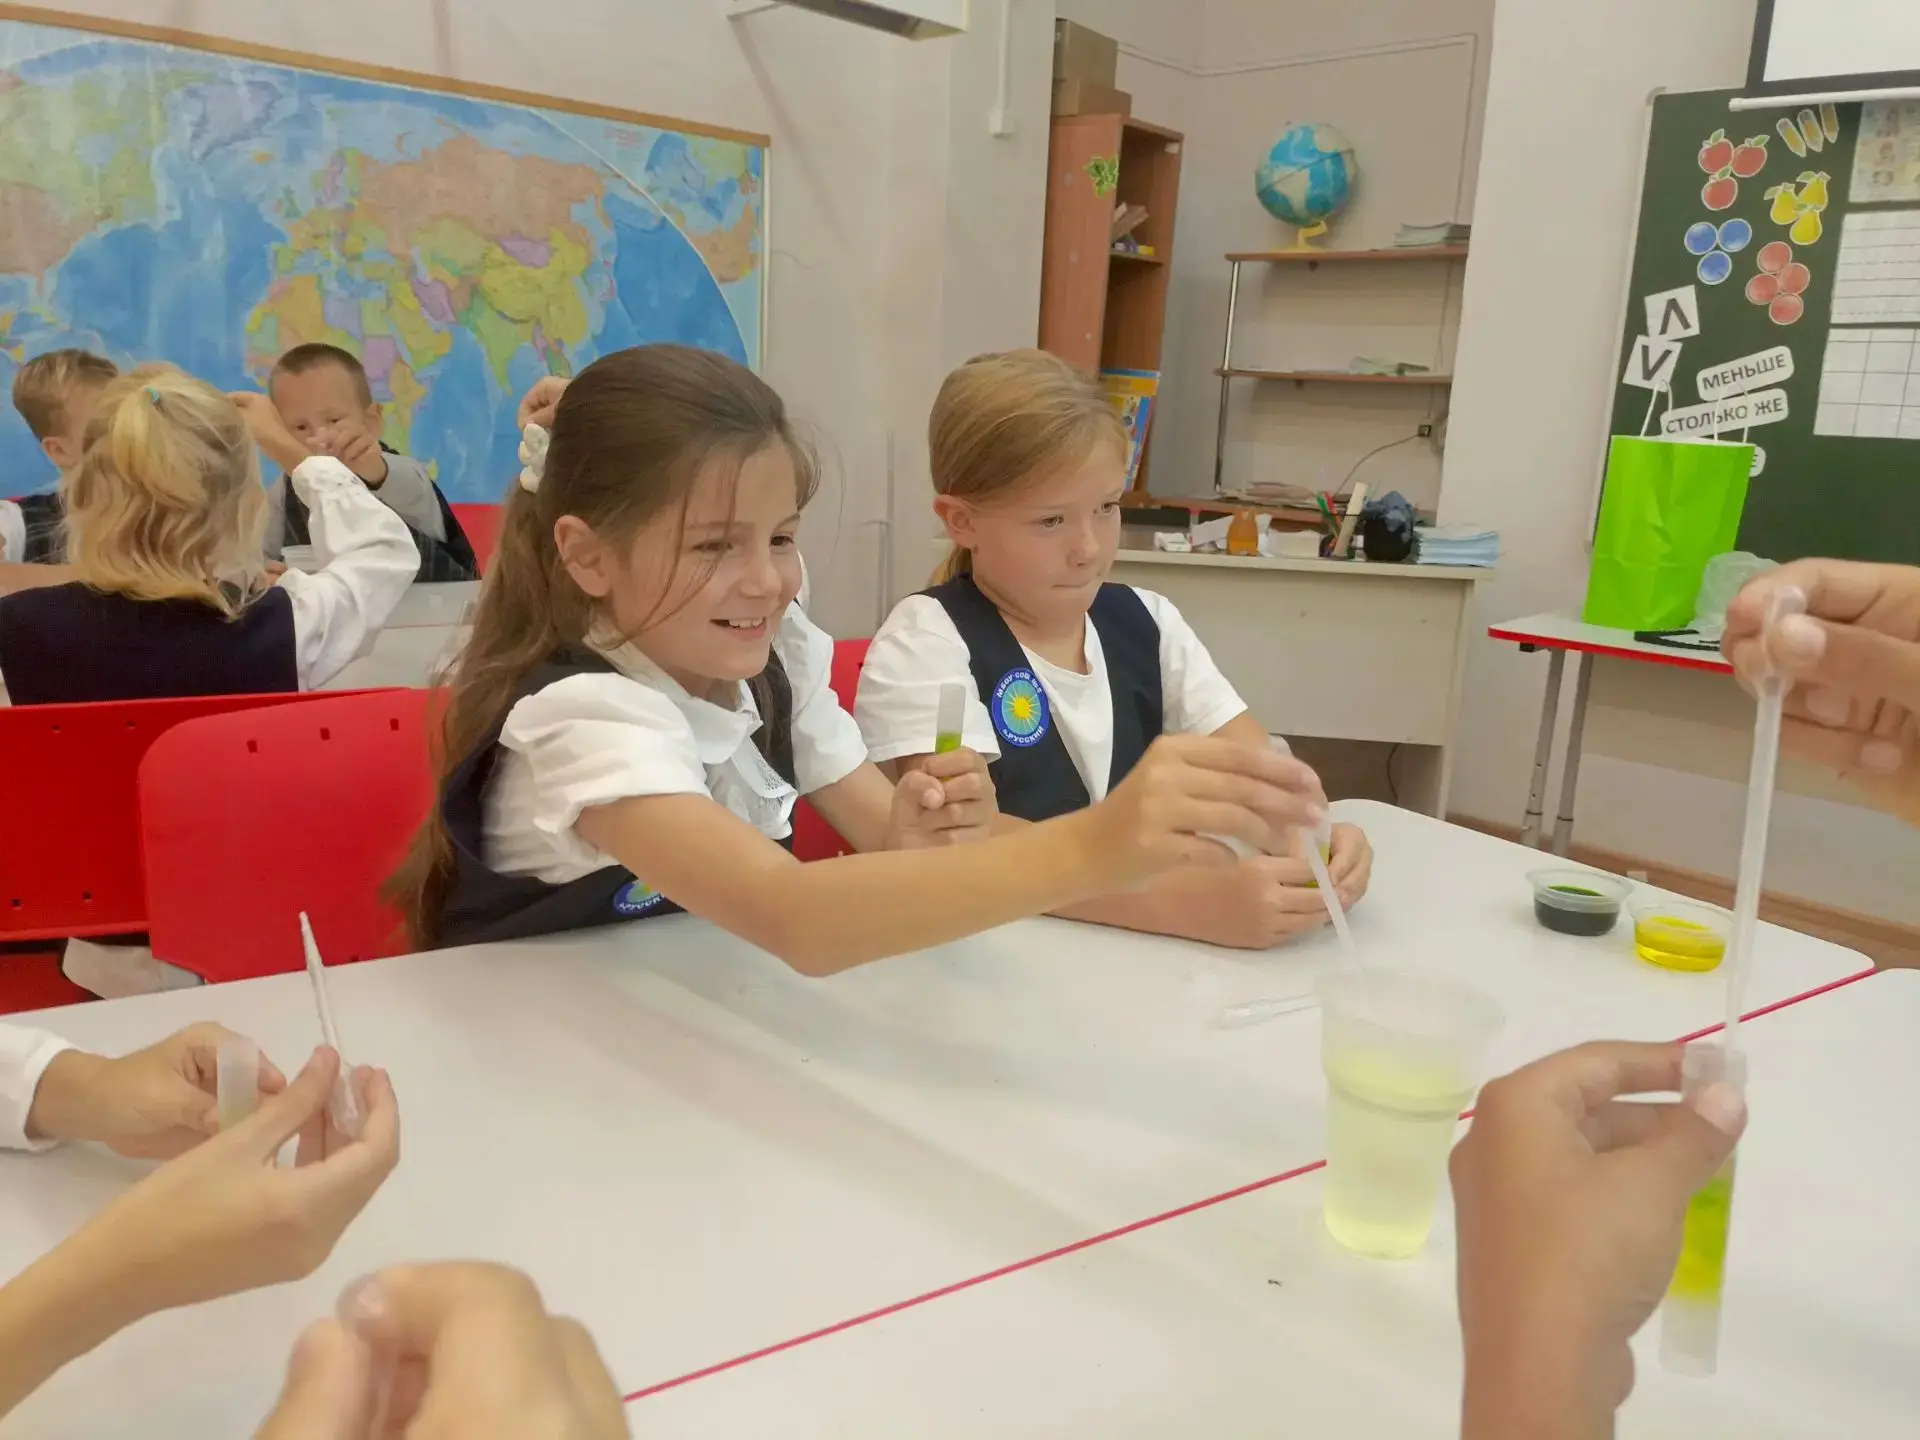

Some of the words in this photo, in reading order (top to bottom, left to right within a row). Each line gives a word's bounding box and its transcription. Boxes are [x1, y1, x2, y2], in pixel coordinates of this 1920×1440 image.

[1702, 354, 1786, 390] МЕНЬШЕ
[1666, 405, 1747, 434] СТОЛЬКО
[1754, 397, 1784, 417] ЖЕ
